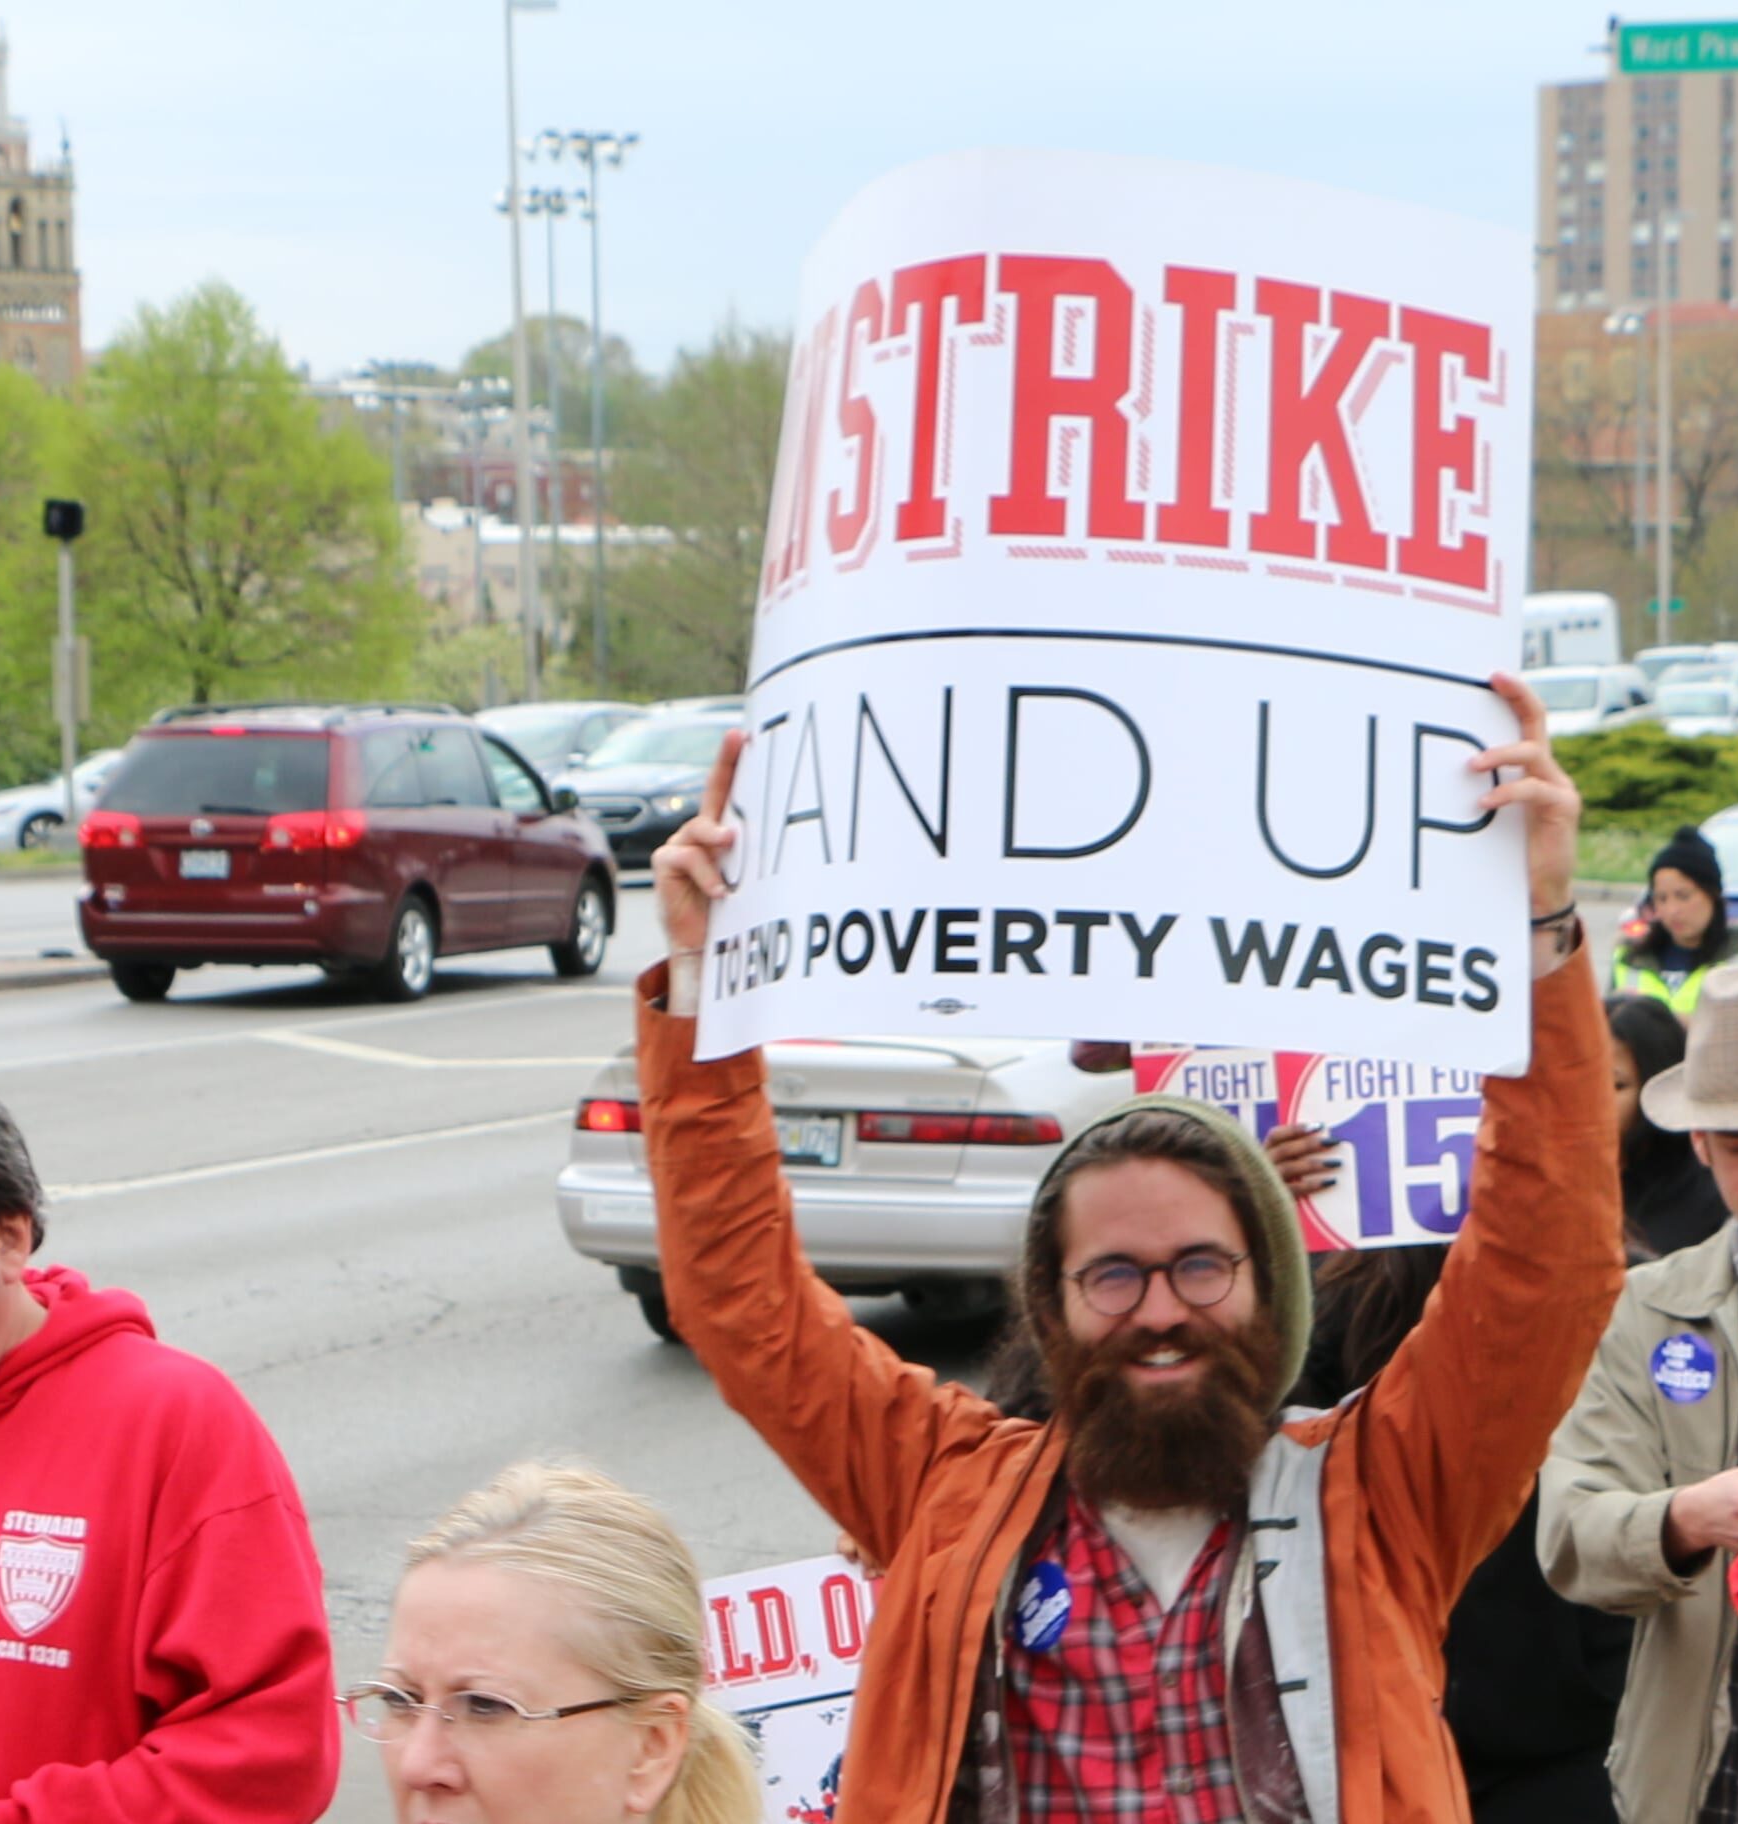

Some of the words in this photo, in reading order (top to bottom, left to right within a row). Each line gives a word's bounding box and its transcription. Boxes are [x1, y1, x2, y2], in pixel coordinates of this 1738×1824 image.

[828, 253, 1508, 615] STRIKE
[1257, 699, 1500, 890] UP
[802, 908, 1181, 979] POVERTY
[1208, 917, 1500, 1013] WAGES
[1183, 1061, 1267, 1102] FIGHT
[1325, 1058, 1415, 1102] FIGHT
[1430, 1065, 1483, 1098] FO
[1329, 1099, 1482, 1240] 15
[2, 1510, 87, 1538] STEWARD
[701, 1584, 819, 1690] LD,
[820, 1572, 885, 1663] O
